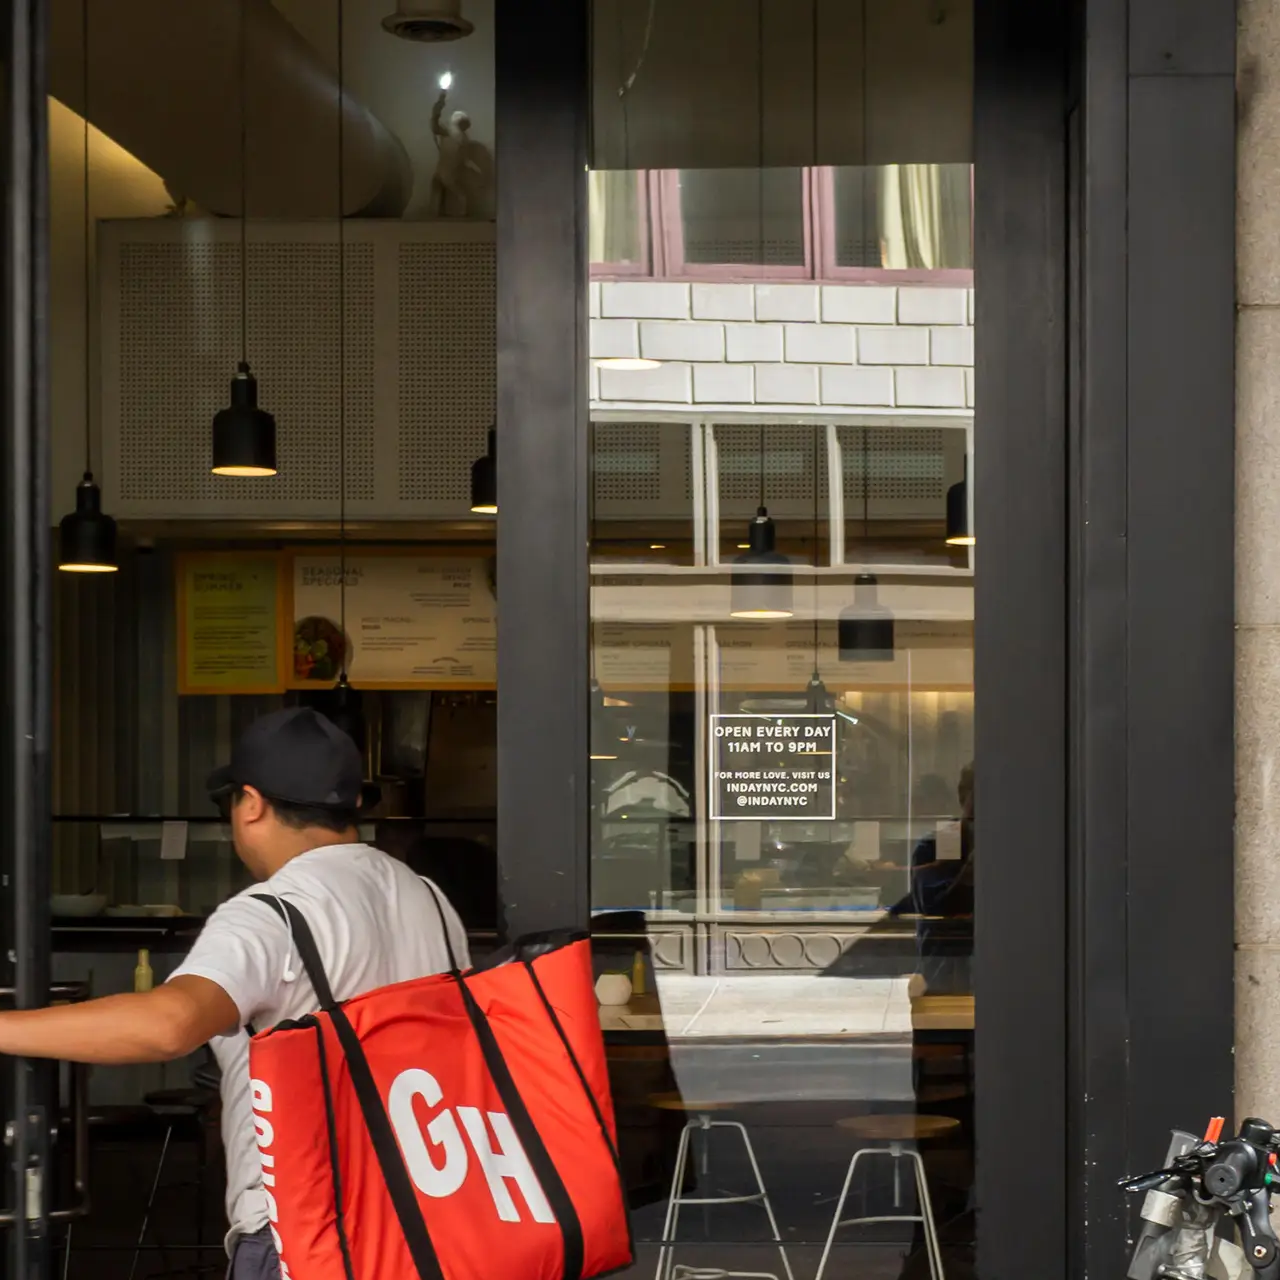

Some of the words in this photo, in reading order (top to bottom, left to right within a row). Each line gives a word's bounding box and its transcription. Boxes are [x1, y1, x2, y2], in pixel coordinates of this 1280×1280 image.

[714, 726, 752, 738] OPEN
[756, 726, 800, 738] EVERY
[804, 726, 832, 738] DAY
[727, 741, 761, 753] 11AM
[765, 741, 784, 753] TO
[788, 741, 817, 753] 9PM
[714, 771, 733, 780] FOR
[734, 771, 761, 780] MORE
[791, 771, 815, 780] VISIT
[817, 771, 831, 780] US
[726, 783, 818, 793] INDAYNYC.COM
[736, 796, 808, 807] @INDAYNYC
[388, 1068, 556, 1223] GH
